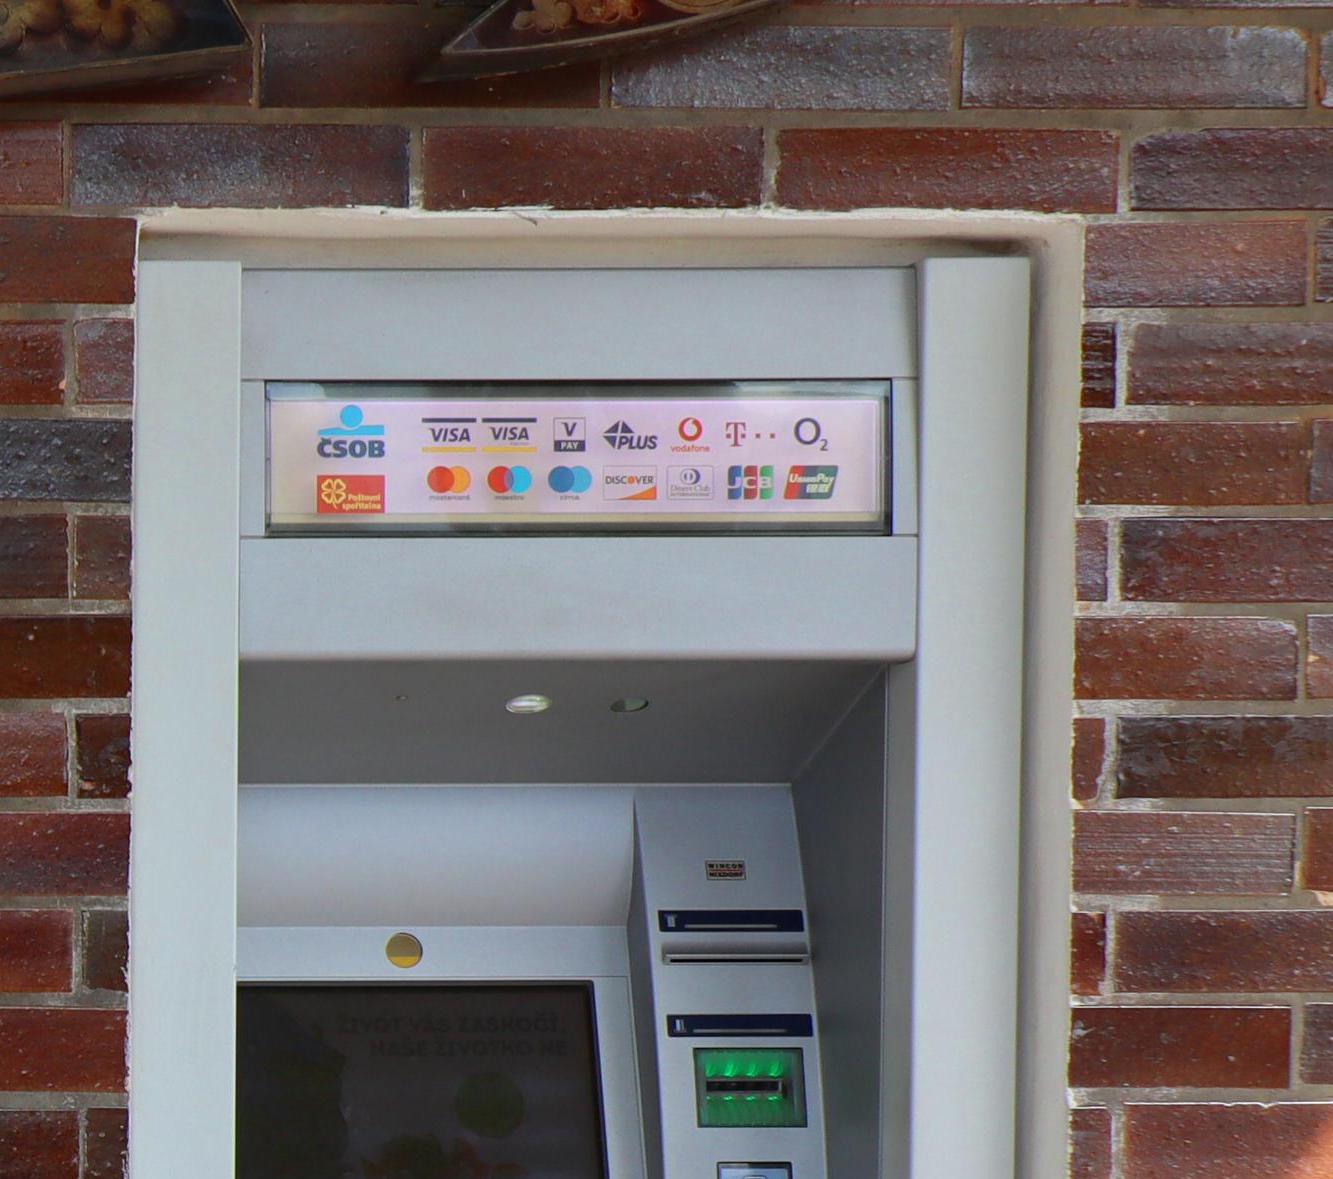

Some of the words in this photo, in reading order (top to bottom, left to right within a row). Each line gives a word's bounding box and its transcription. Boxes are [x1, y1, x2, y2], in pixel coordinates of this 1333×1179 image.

[429, 427, 470, 442] VISA
[490, 426, 530, 441] VISA
[561, 422, 577, 437] V
[317, 437, 385, 459] ČSOB
[561, 441, 579, 450] PAY
[617, 435, 658, 449] PLUS
[604, 475, 654, 485] DISCOVER
[728, 475, 773, 488] JCB
[342, 501, 382, 511] spořitelna
